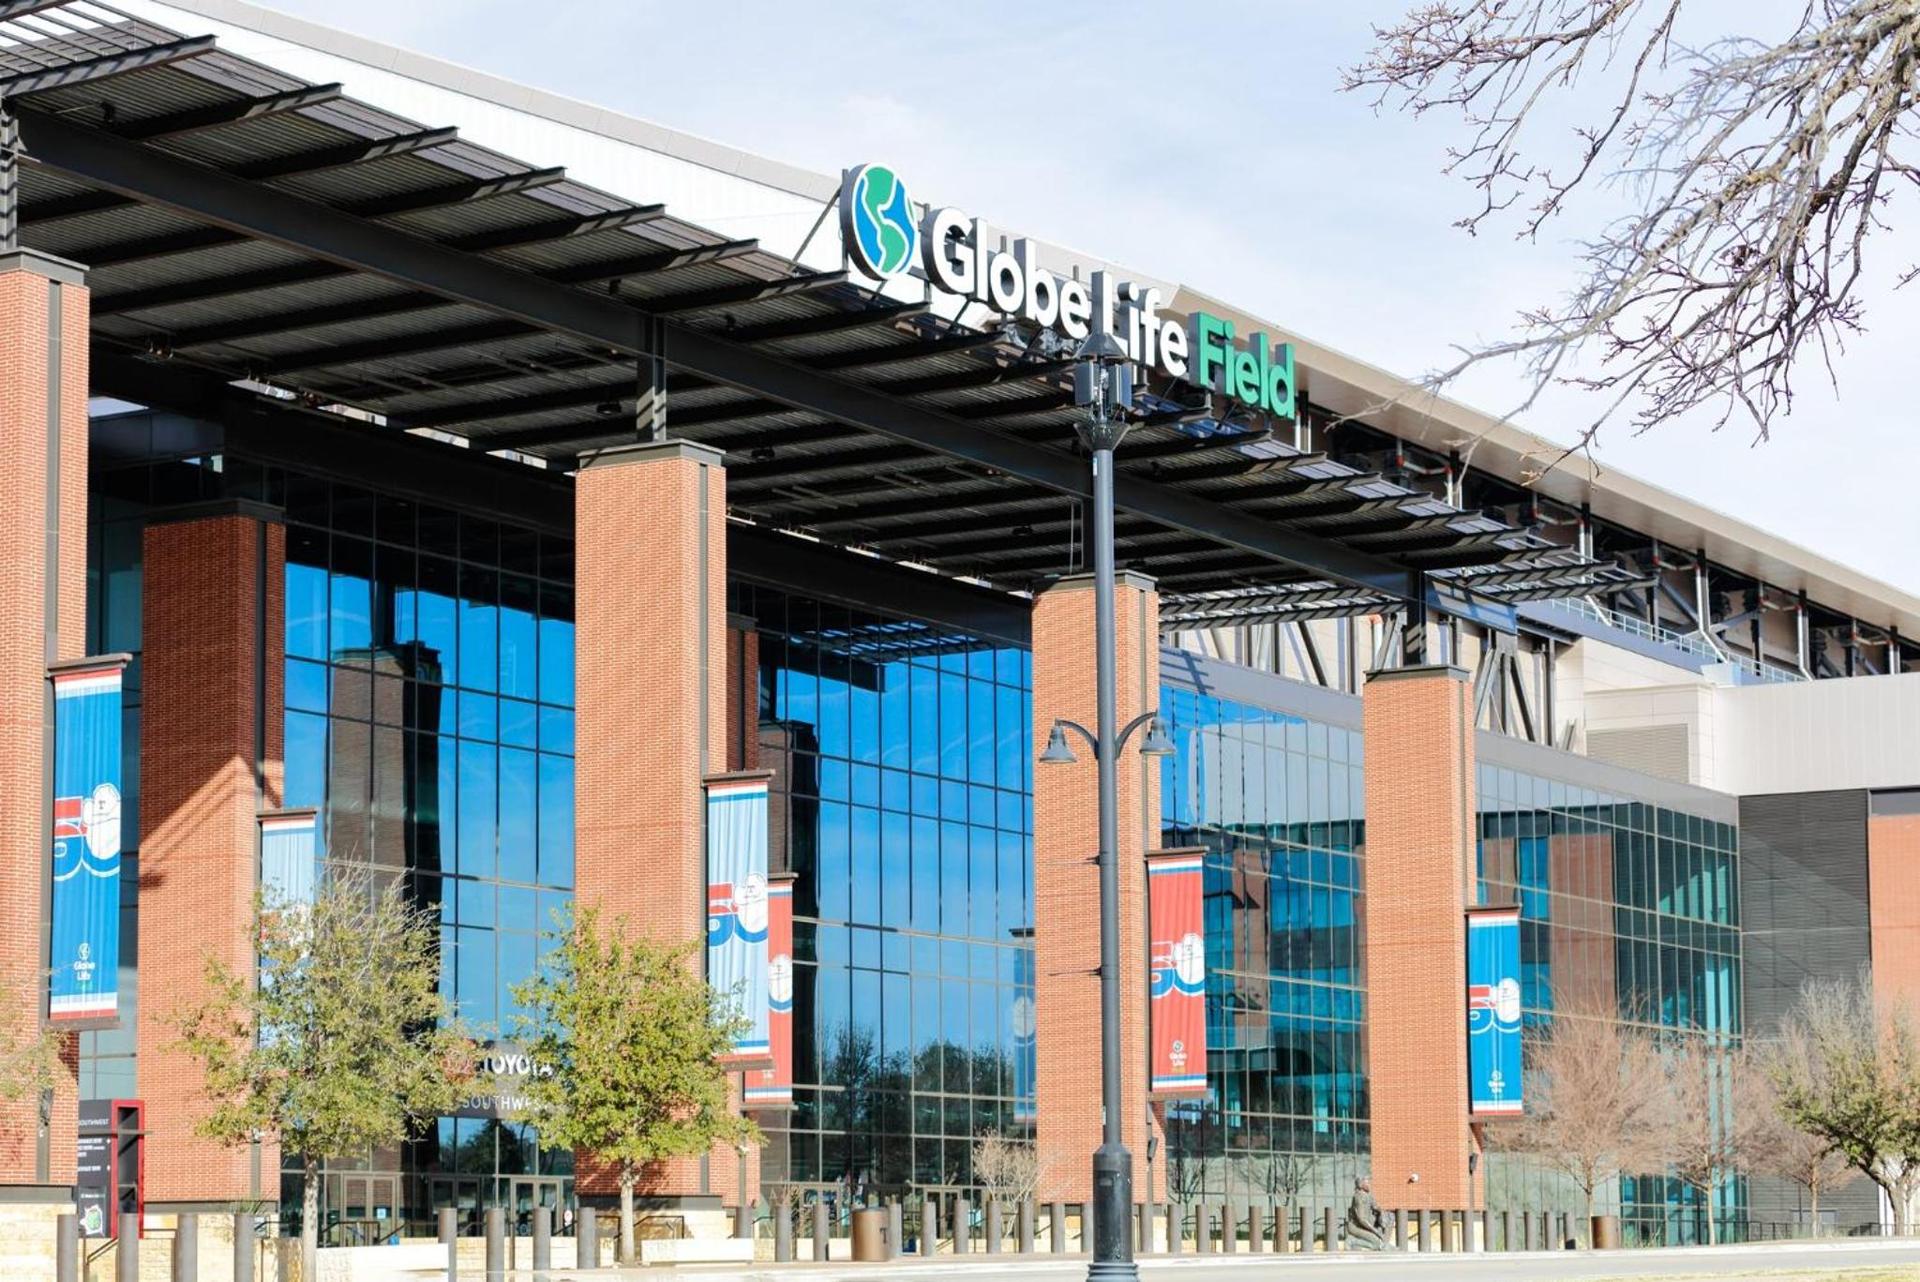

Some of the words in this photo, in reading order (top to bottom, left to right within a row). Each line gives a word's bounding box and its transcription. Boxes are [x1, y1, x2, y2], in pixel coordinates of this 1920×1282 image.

[924, 207, 1091, 340] Globe
[1094, 270, 1188, 377] Life
[1192, 311, 1295, 420] Field
